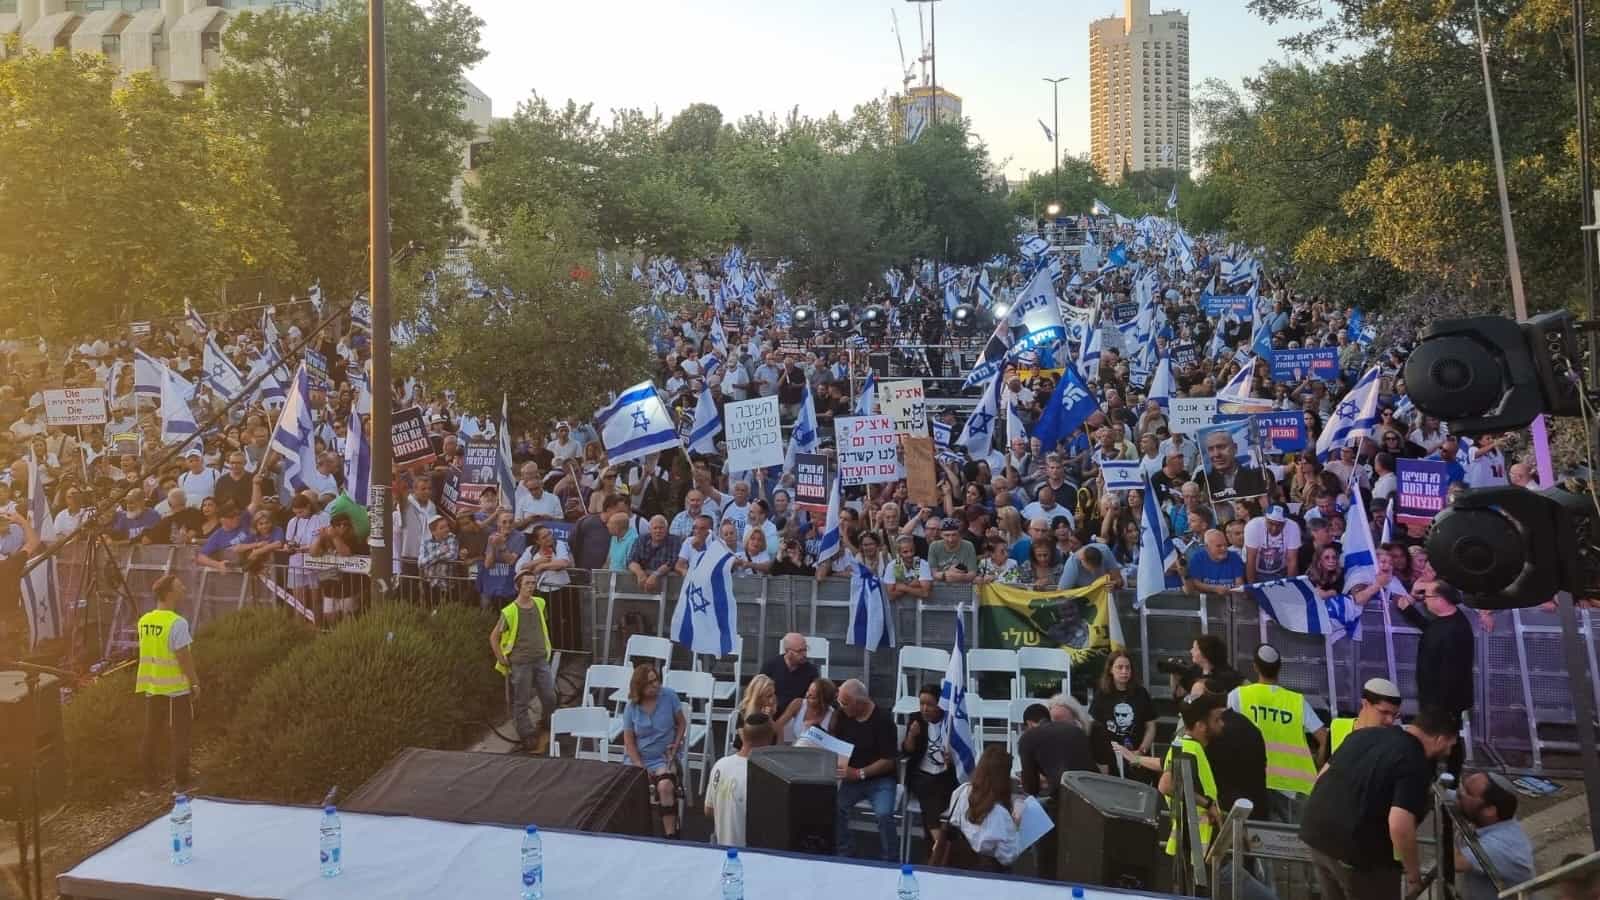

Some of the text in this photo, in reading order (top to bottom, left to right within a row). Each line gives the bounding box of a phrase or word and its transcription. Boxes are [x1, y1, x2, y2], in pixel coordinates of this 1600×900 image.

[855, 418, 889, 432] איציק
[1275, 418, 1298, 426] מינוי
[853, 436, 865, 447] גם
[879, 447, 896, 460] לנו
[879, 464, 896, 475] עם
[1001, 627, 1041, 647] שלי
[1250, 705, 1293, 725] סדרן
